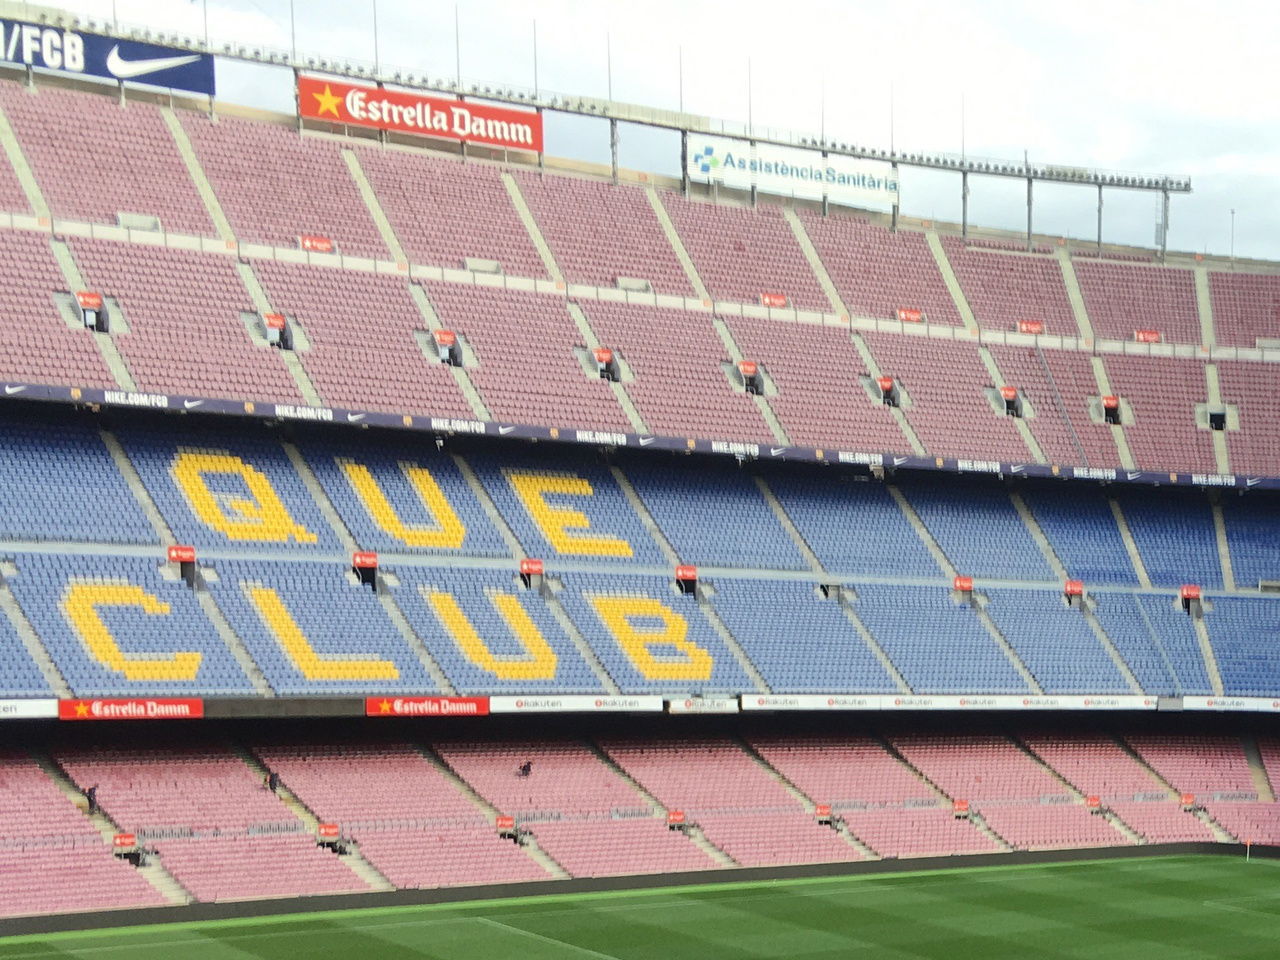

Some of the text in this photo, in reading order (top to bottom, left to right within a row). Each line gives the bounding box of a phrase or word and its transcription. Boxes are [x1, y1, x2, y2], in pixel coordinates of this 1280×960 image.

[0, 21, 84, 73] /FCB
[345, 88, 533, 145] Estrella Damm
[723, 152, 898, 191] Assistència Sanitària
[170, 450, 634, 557] QUE
[62, 582, 713, 680] CLUB
[92, 701, 190, 717] Estrella Damm
[393, 699, 477, 714] Estrella Damm
